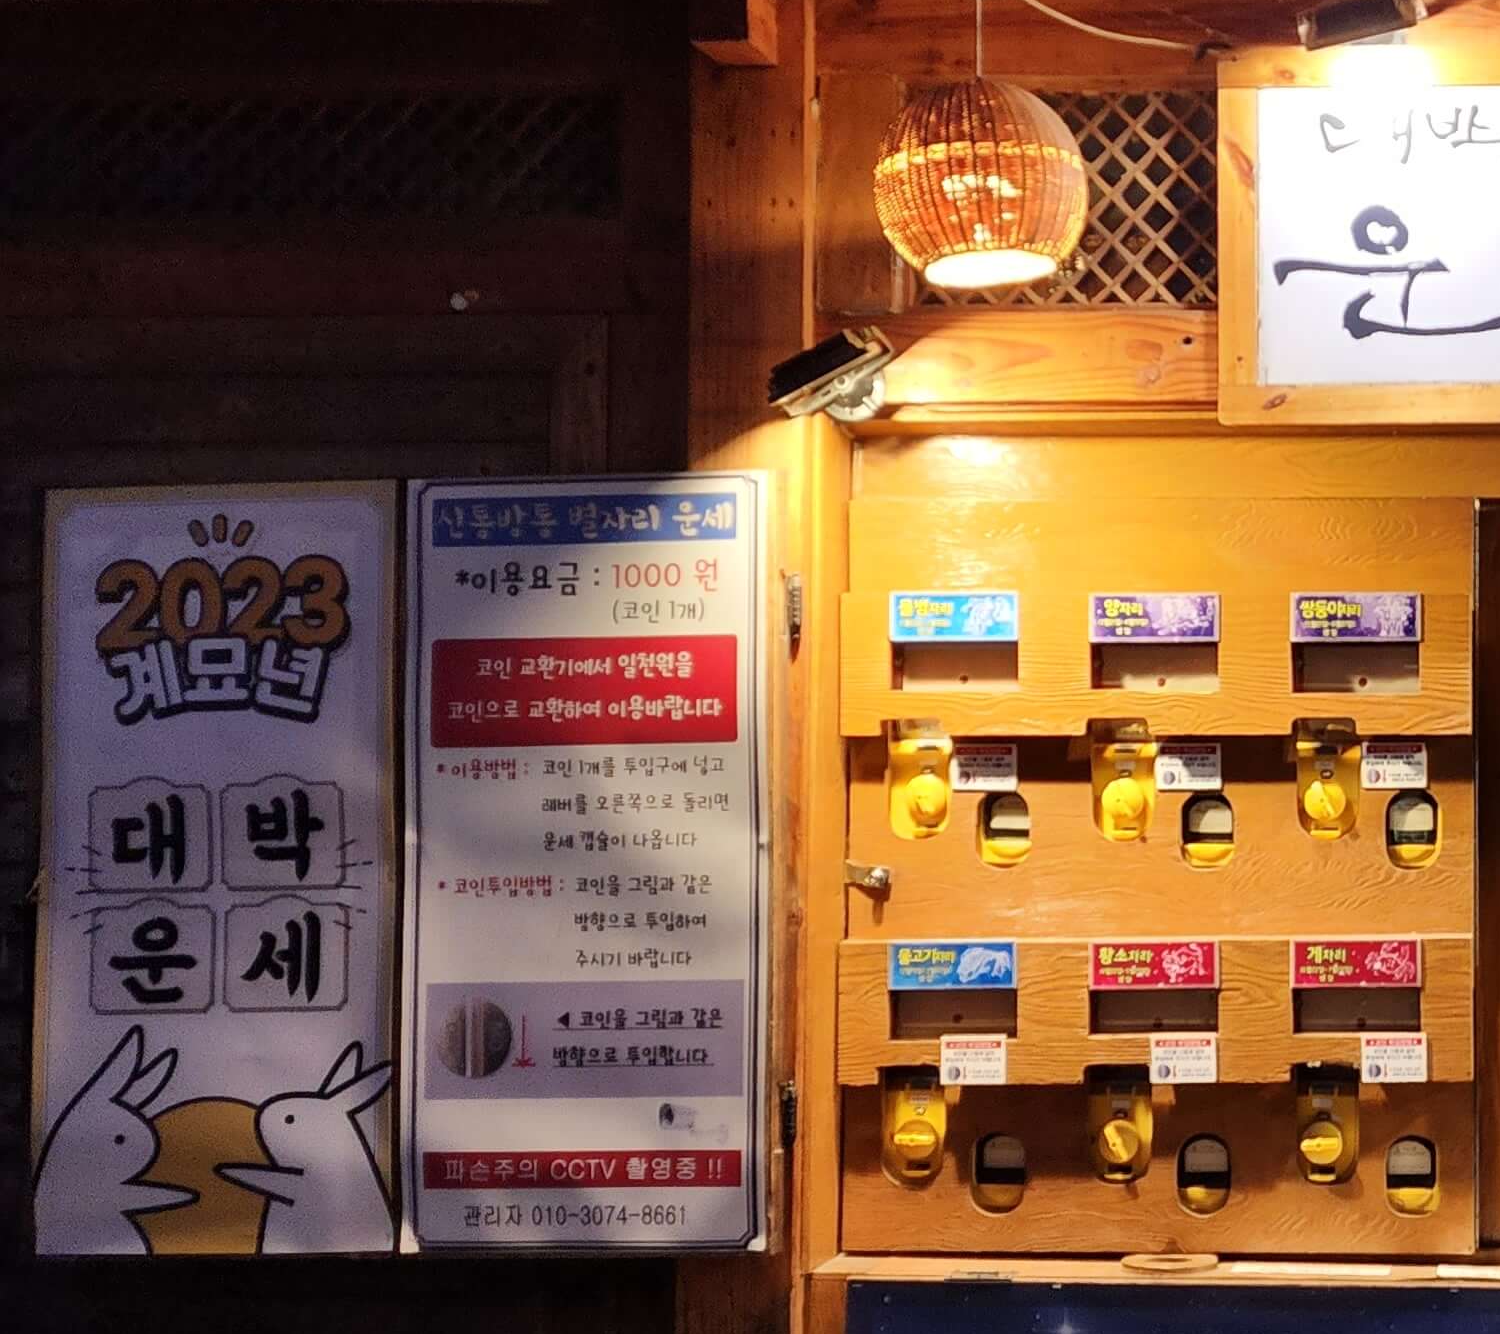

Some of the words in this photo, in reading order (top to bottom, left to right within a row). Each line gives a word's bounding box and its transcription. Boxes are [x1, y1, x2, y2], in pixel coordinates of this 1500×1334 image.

[436, 504, 558, 541] 신통방통
[570, 502, 660, 540] 별자리
[672, 501, 734, 536] 운세
[612, 563, 681, 589] 1000
[695, 559, 718, 591] 원
[96, 556, 350, 650] 2023
[612, 600, 660, 624] (코인
[668, 599, 704, 622] 1개)
[1103, 598, 1144, 618] 양자리
[1300, 600, 1363, 620] 쌍둥이자리
[477, 658, 513, 679] 코인
[520, 654, 614, 677] 교환기에서
[618, 652, 693, 679] 일천원을
[110, 639, 326, 720] 계묘년
[448, 701, 520, 722] 코인으로
[528, 699, 601, 721] 교환하여
[608, 695, 723, 721] 이용바랍니다
[452, 759, 517, 780] 이용방법
[543, 758, 573, 778] 코인
[578, 757, 615, 777] 1개를
[624, 757, 687, 776] 투입구에
[693, 757, 725, 776] 넣고
[542, 793, 588, 814] 레버를
[595, 793, 673, 813] 오른쪽으로
[683, 793, 729, 812] 돌리면
[543, 832, 574, 851] 운세
[580, 830, 626, 851] 캡슐이
[632, 830, 697, 850] 나옵니다
[454, 877, 553, 898] 코인투입방법
[576, 875, 620, 896] 코인을
[628, 875, 675, 894] 그림과
[681, 874, 713, 894] 같은
[574, 913, 637, 931] 방향으로
[645, 911, 707, 930] 투입하여
[576, 949, 621, 968] 주시기
[628, 948, 691, 967] 바랍니다
[898, 946, 957, 964] 물고기자리
[1098, 945, 1154, 964] 황소자리
[1306, 945, 1347, 963] 게자리
[580, 1010, 628, 1029] 코인을
[635, 1009, 683, 1028] 그림과
[691, 1008, 723, 1028] 같은
[553, 1046, 617, 1066] 방향으로
[626, 1046, 708, 1066] 투입합니다
[444, 1159, 538, 1182] 파손주의
[550, 1159, 616, 1178] CCTV
[626, 1157, 697, 1180] 촬영중
[464, 1205, 522, 1228] 관리자
